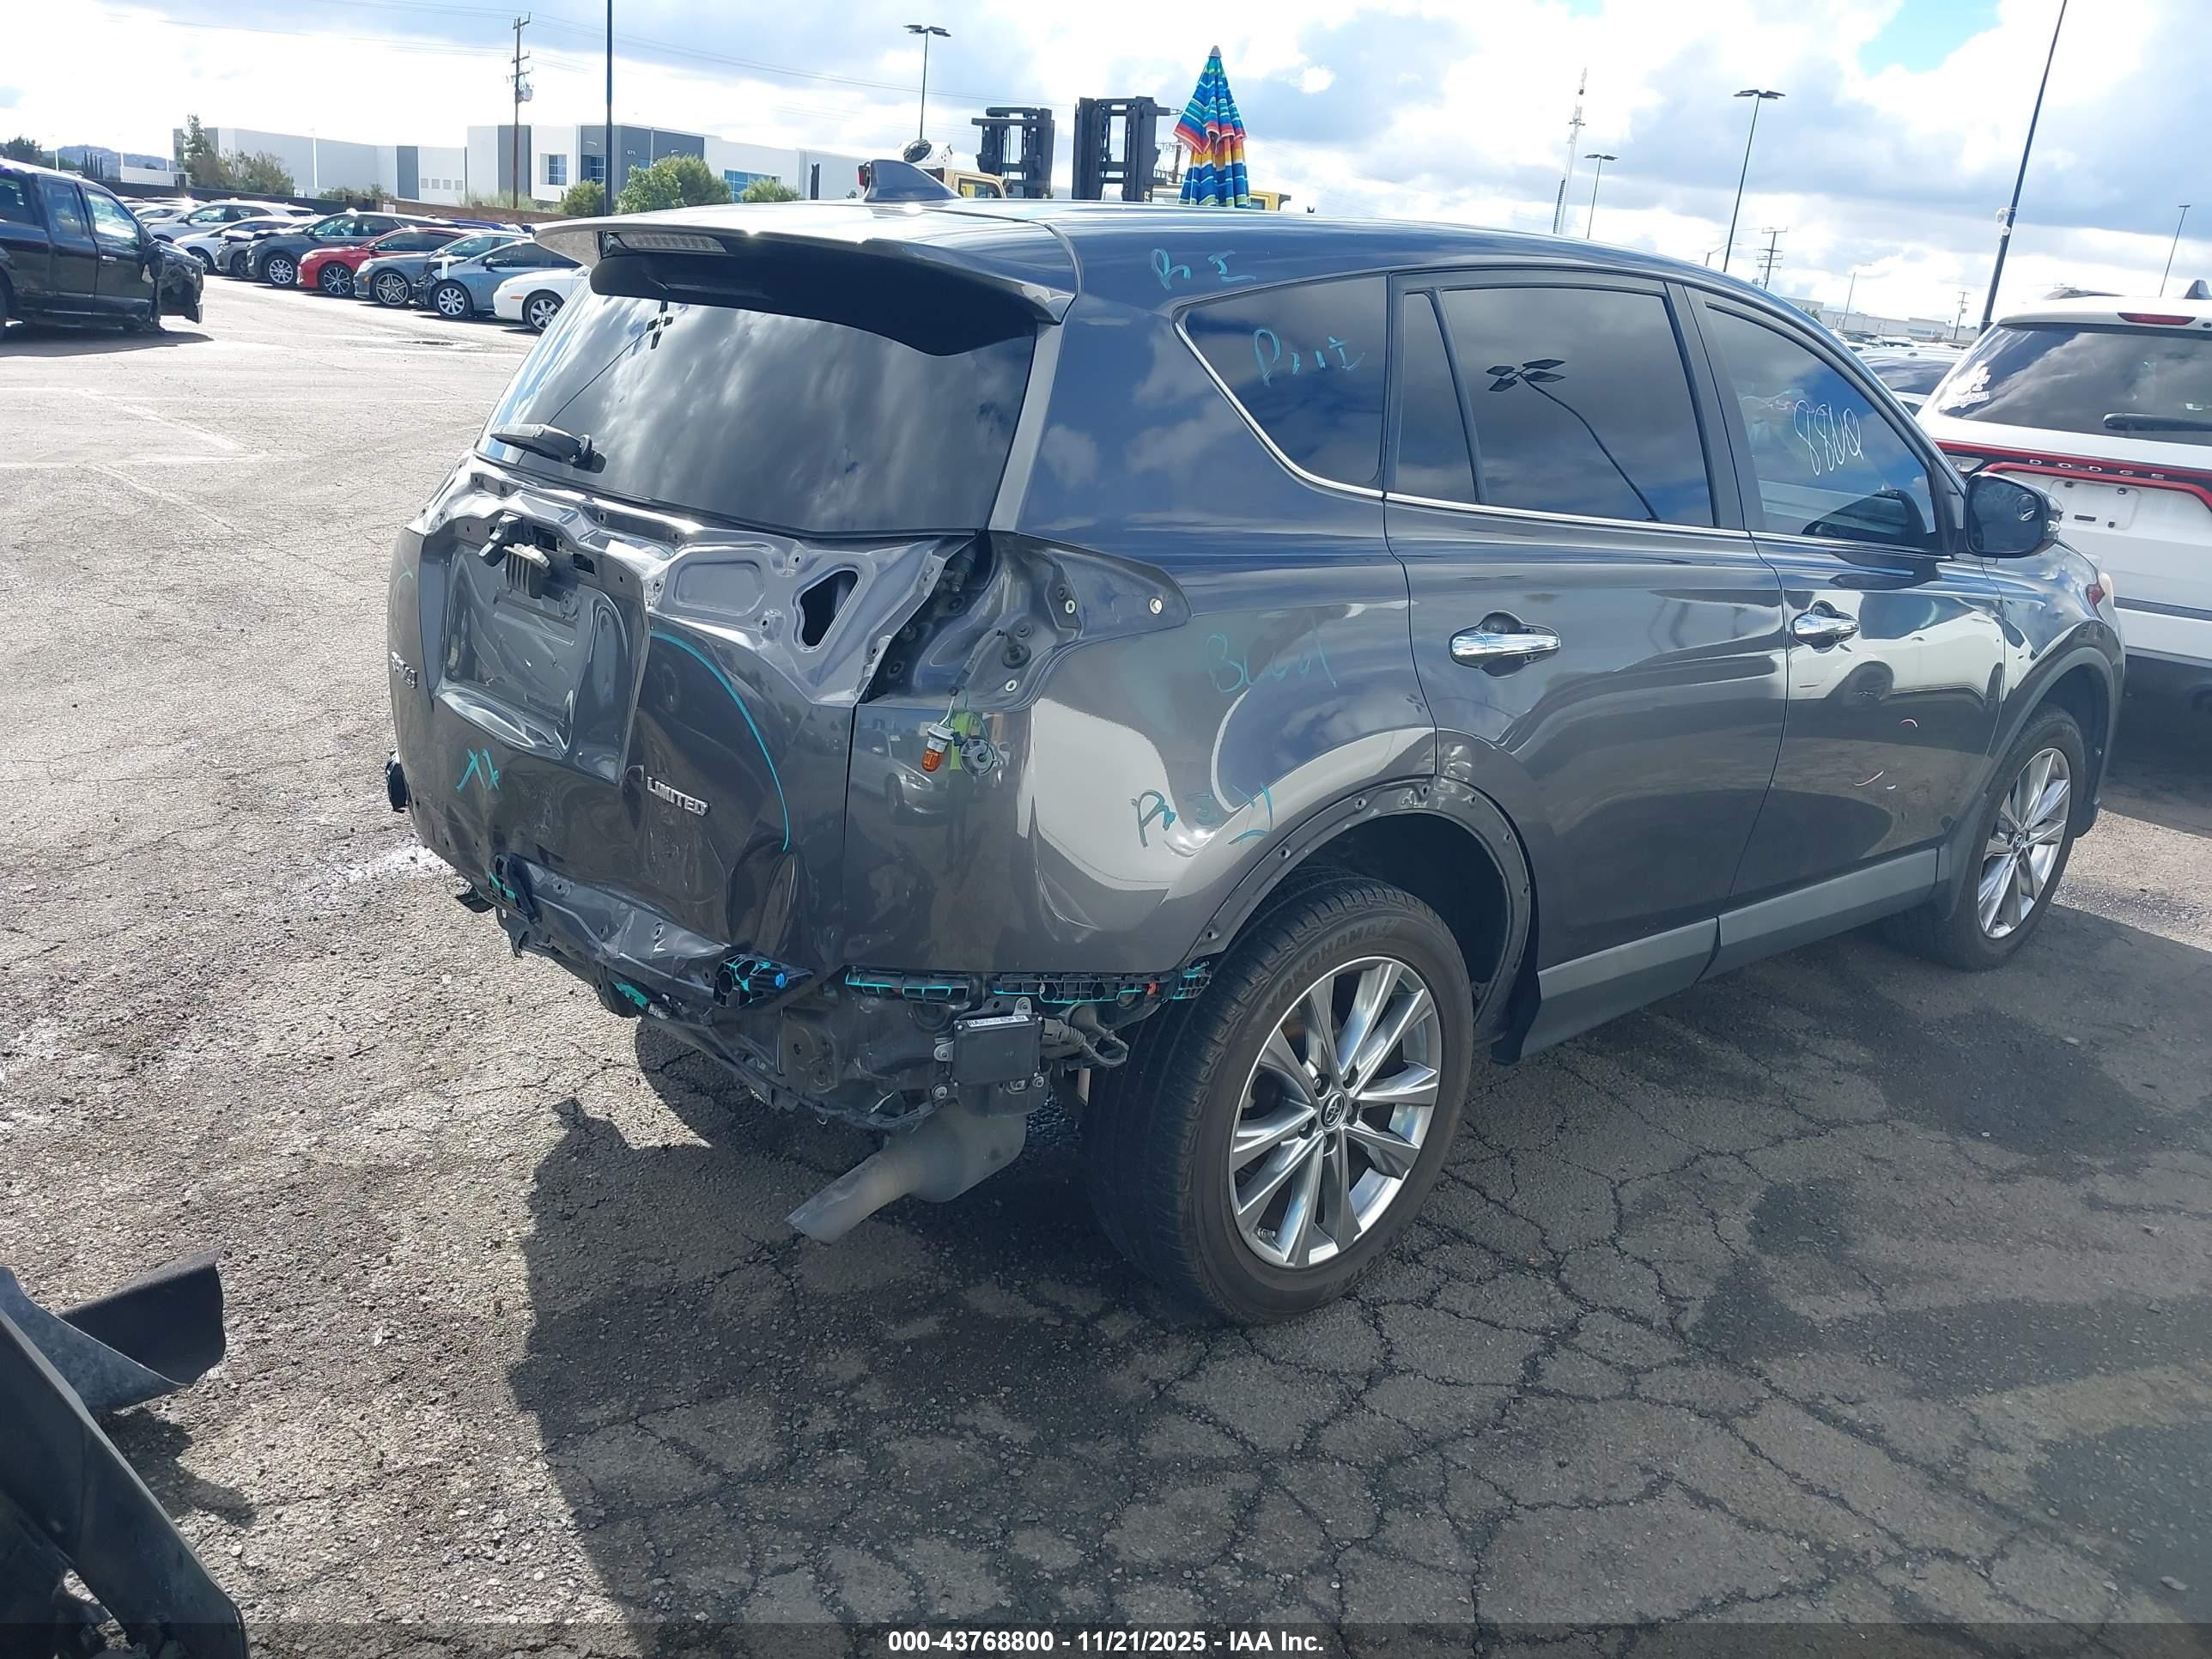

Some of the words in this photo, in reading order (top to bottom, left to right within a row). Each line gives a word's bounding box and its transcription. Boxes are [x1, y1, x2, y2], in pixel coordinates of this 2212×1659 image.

[2028, 458, 2165, 481] DODGE
[647, 775, 708, 817] LIMITED
[1266, 922, 1377, 1012] YOKOHAMA
